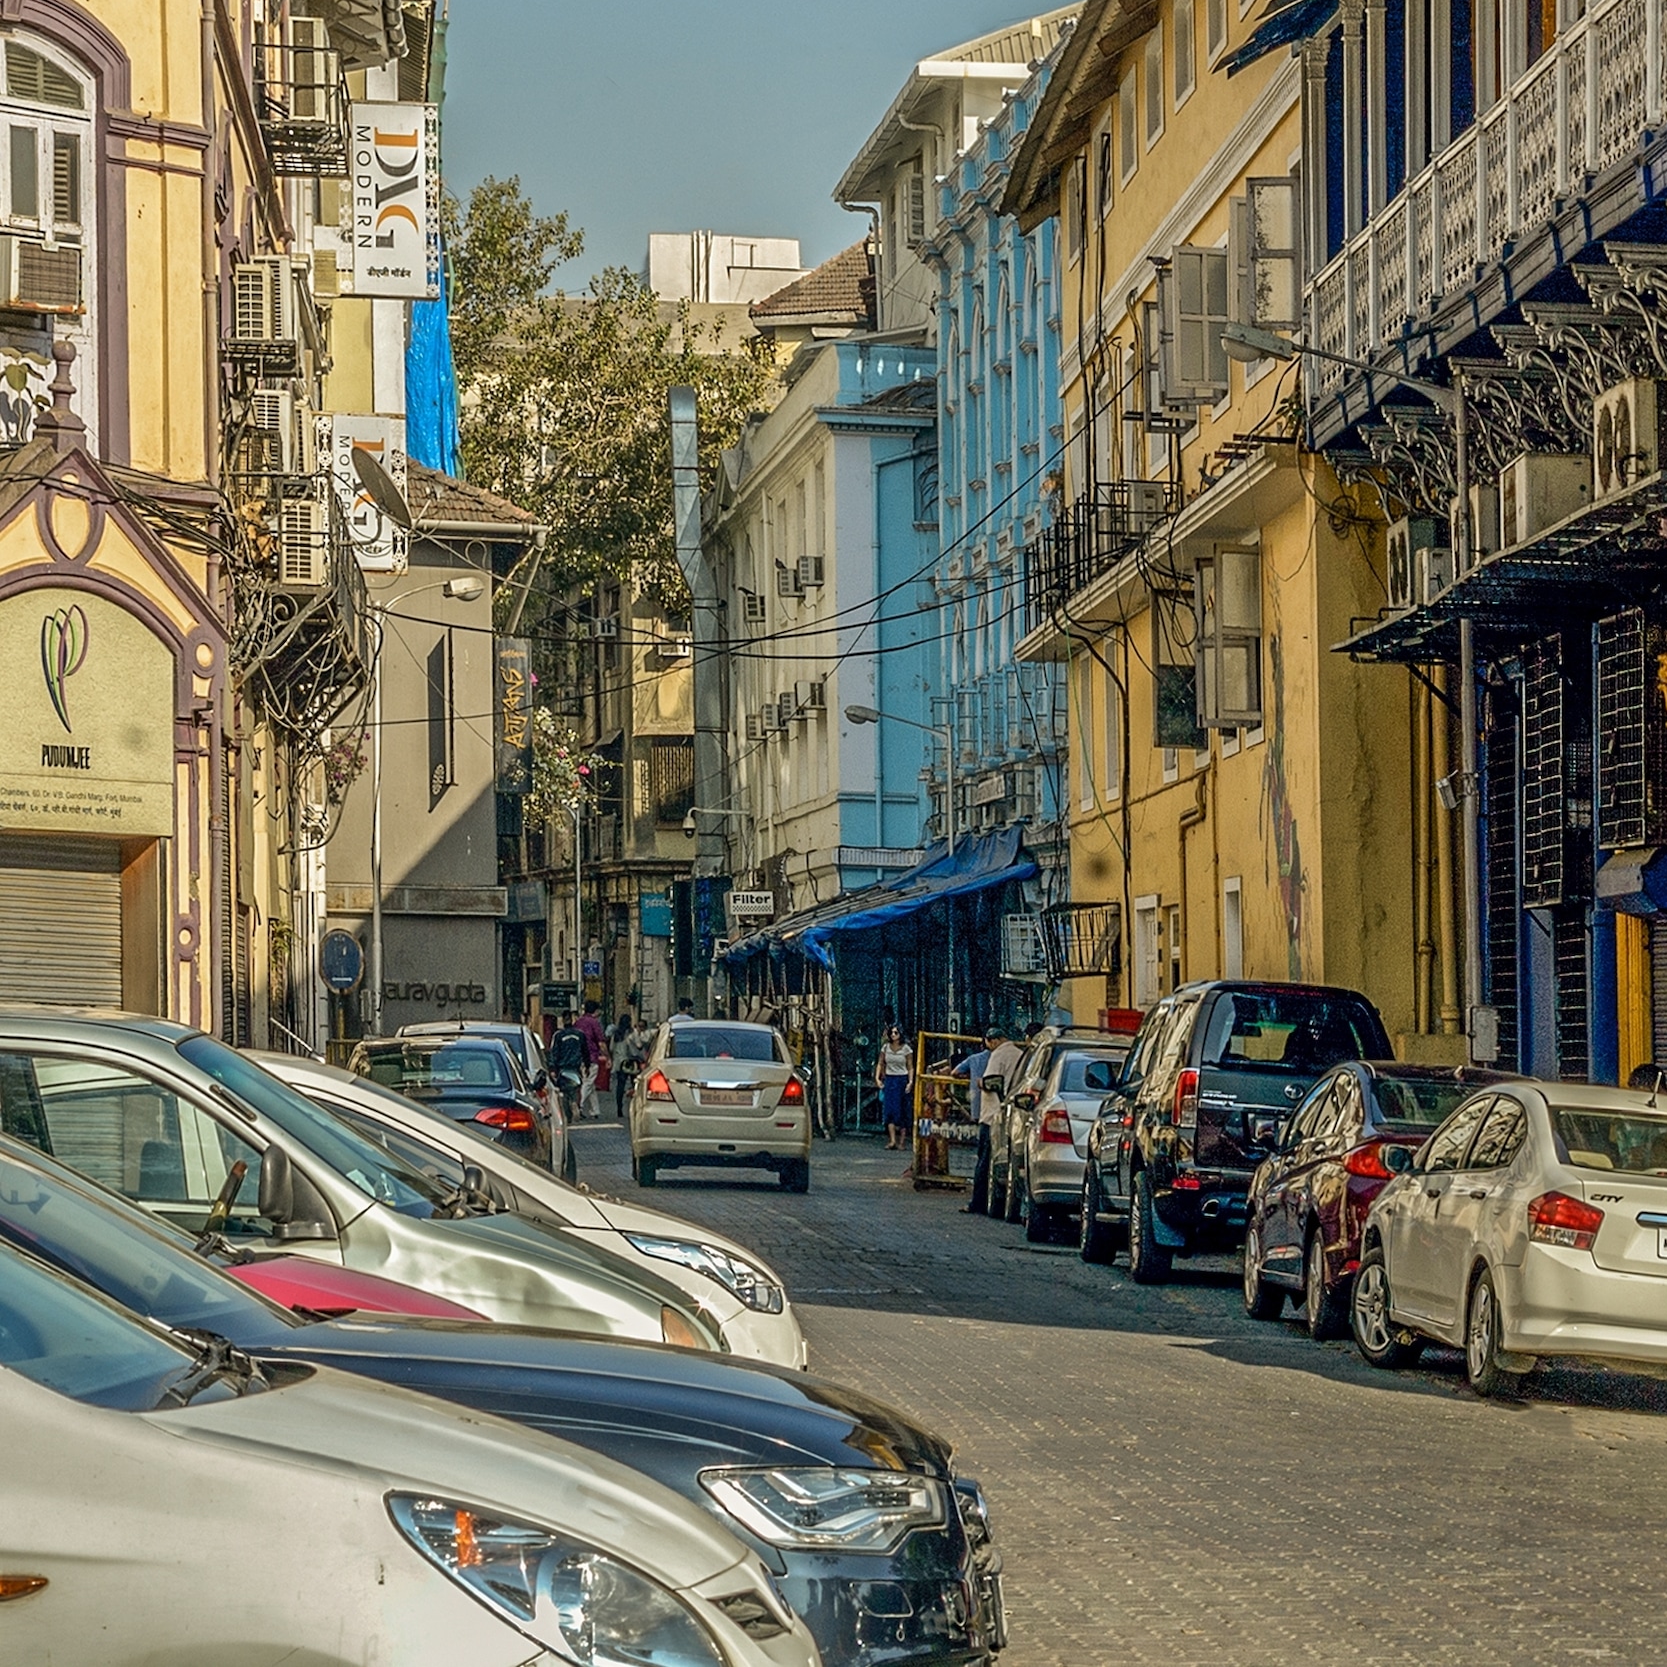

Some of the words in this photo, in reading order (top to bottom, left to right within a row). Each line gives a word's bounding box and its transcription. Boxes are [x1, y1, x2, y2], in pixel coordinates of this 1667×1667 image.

[356, 125, 372, 248] MODERN
[732, 894, 771, 904] Filter
[1590, 1194, 1624, 1203] CITY
